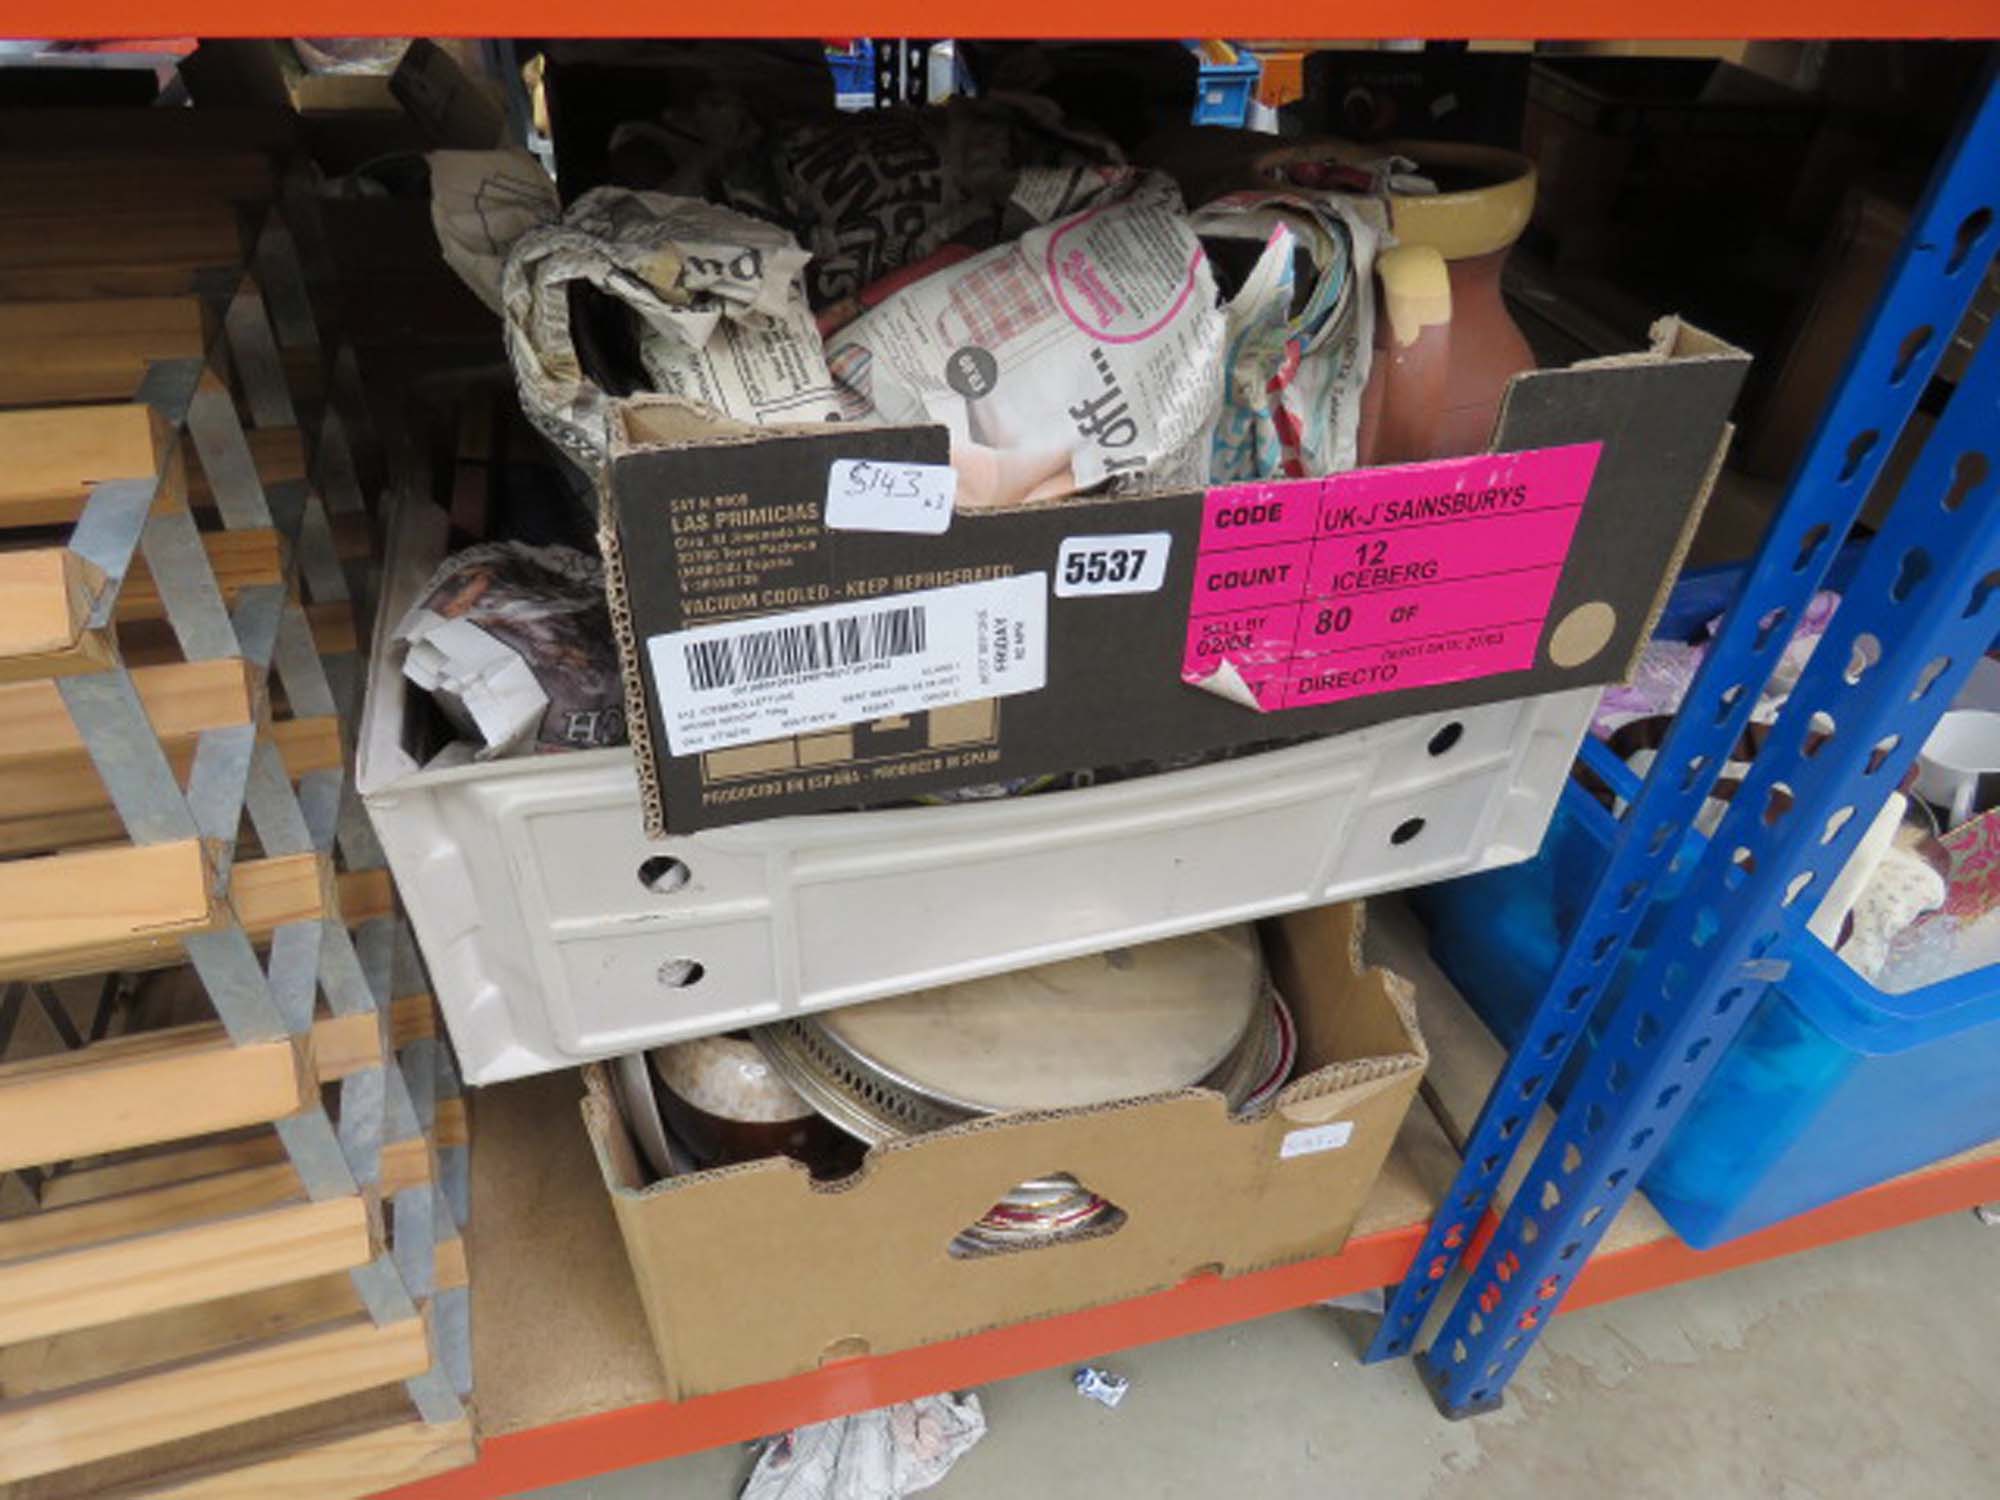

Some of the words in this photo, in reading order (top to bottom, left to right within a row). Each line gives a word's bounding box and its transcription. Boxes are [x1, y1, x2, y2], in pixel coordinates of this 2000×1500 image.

[670, 513, 710, 534] LAS
[1214, 502, 1283, 529] CODE
[1064, 549, 1148, 585] 5537
[1355, 538, 1389, 567] 12
[1207, 564, 1292, 592] COUNT
[1331, 559, 1439, 592] ICEBERG
[679, 591, 758, 616] VACUUM
[760, 583, 830, 607] COOLED
[845, 576, 889, 598] KEEP
[1314, 605, 1353, 636] 80
[1389, 604, 1419, 623] OF
[1298, 663, 1399, 695] DIRECTO
